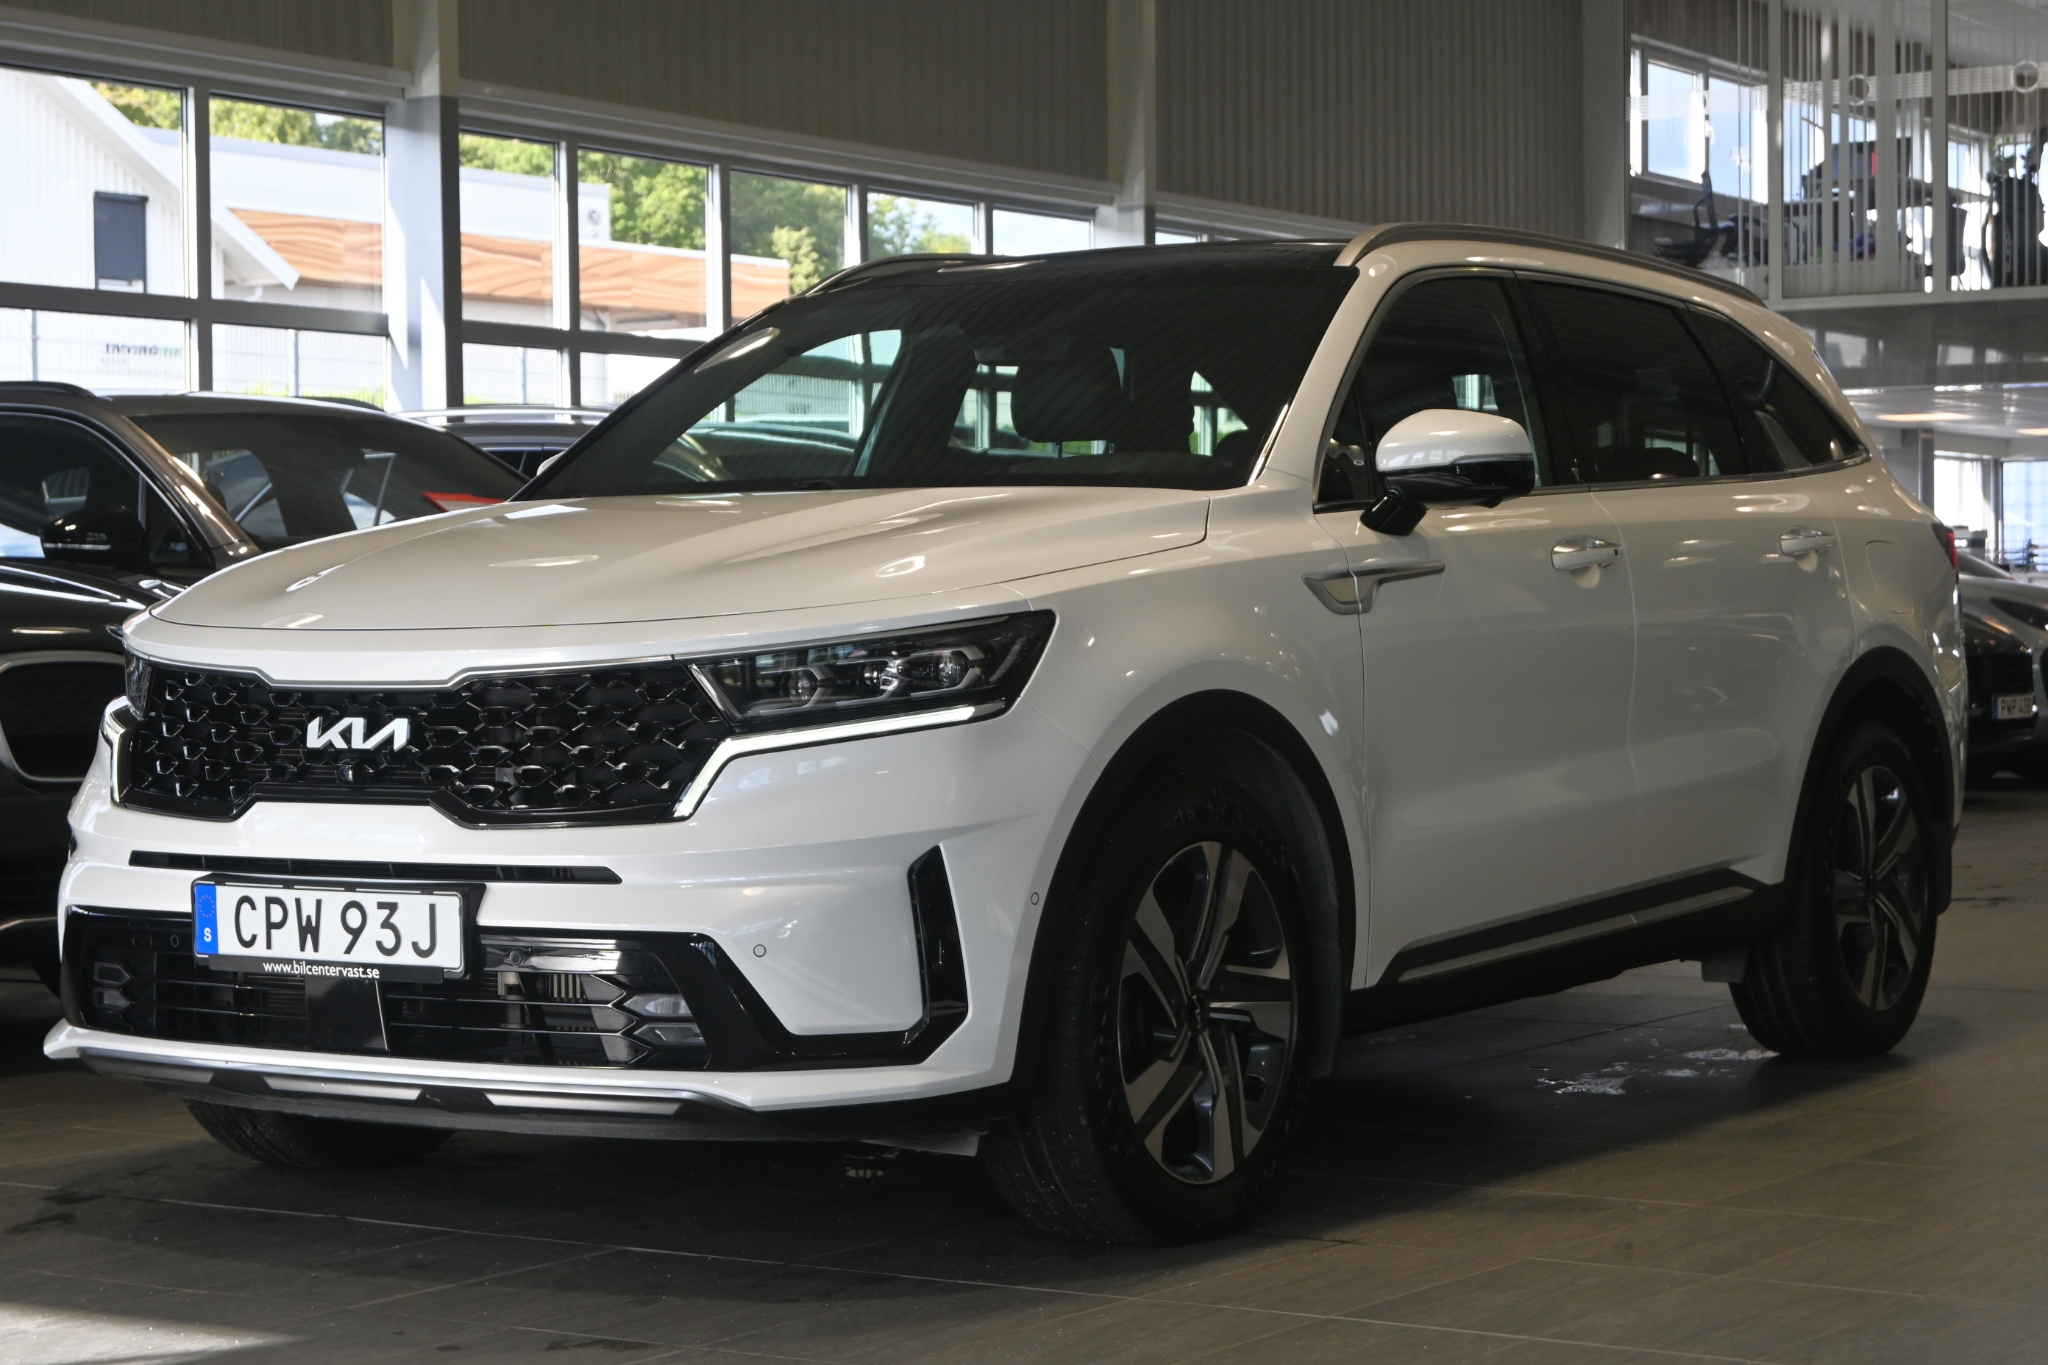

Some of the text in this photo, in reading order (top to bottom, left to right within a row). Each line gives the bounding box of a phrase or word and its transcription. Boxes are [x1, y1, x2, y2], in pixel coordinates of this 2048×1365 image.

[306, 716, 410, 752] KIA
[203, 927, 212, 942] S
[234, 895, 438, 958] CPW 93J
[263, 960, 380, 979] www.bilcentervast.se
